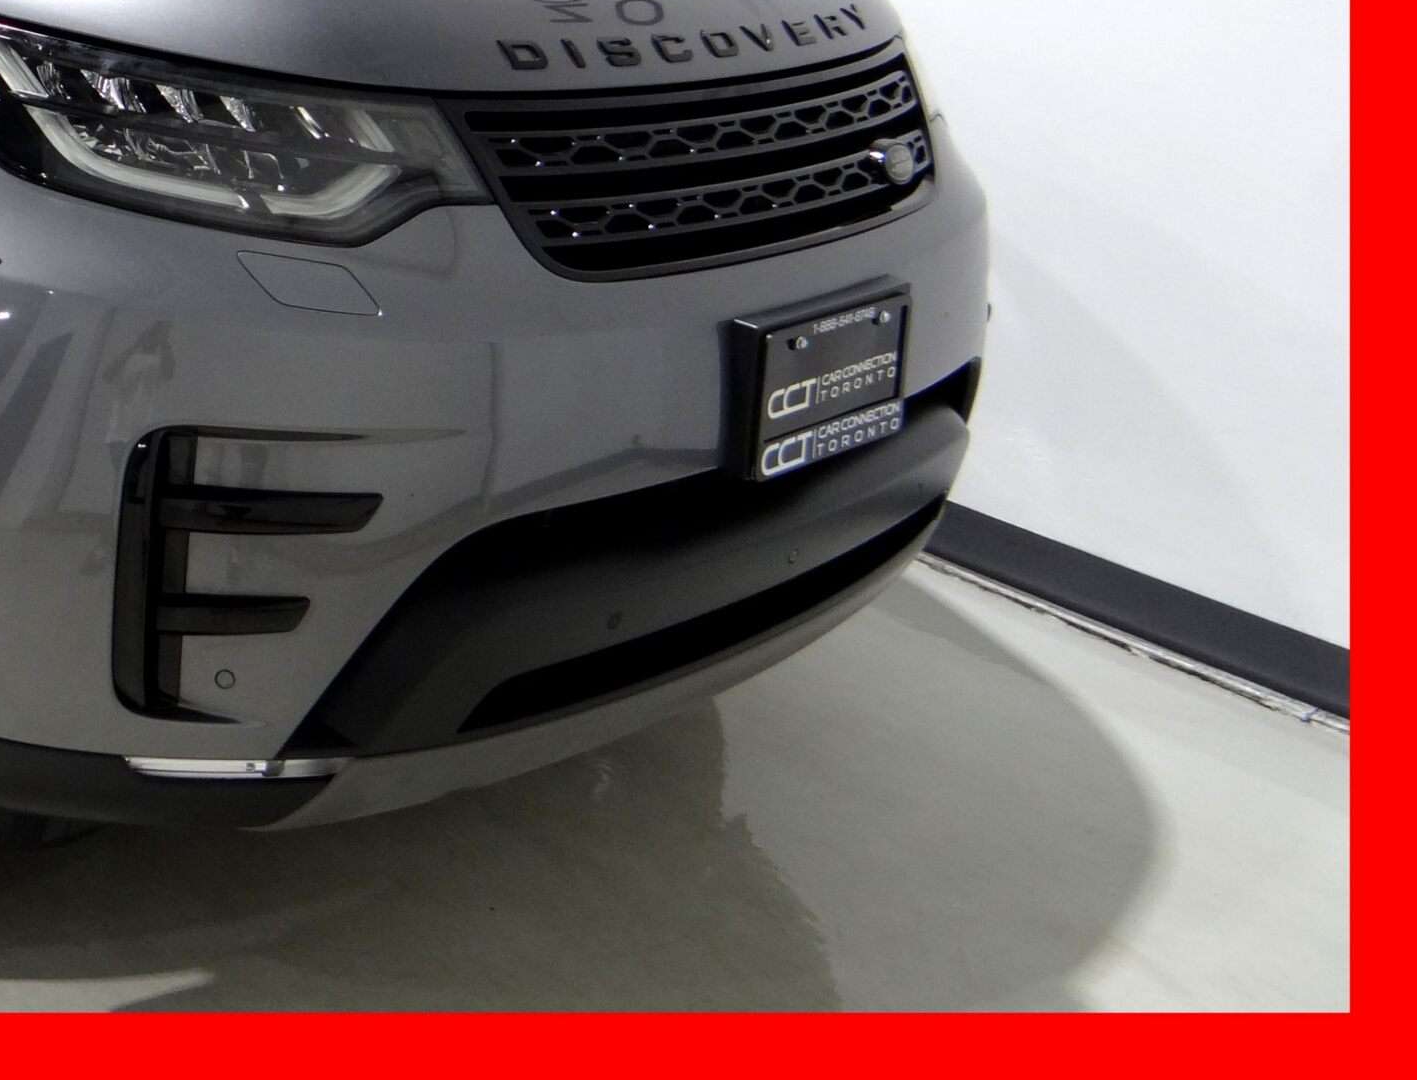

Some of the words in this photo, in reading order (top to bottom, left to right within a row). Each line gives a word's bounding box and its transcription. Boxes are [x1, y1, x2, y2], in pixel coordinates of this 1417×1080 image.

[496, 3, 868, 71] DISCOVERY
[820, 366, 896, 401] TORONTO
[821, 370, 841, 386] CAR
[841, 352, 897, 378] CONNECTION
[768, 377, 818, 419] CCT
[816, 418, 899, 451] TORONTO
[818, 422, 840, 439] CAR
[840, 402, 900, 429] CONNECTION
[761, 430, 814, 476] CCT
